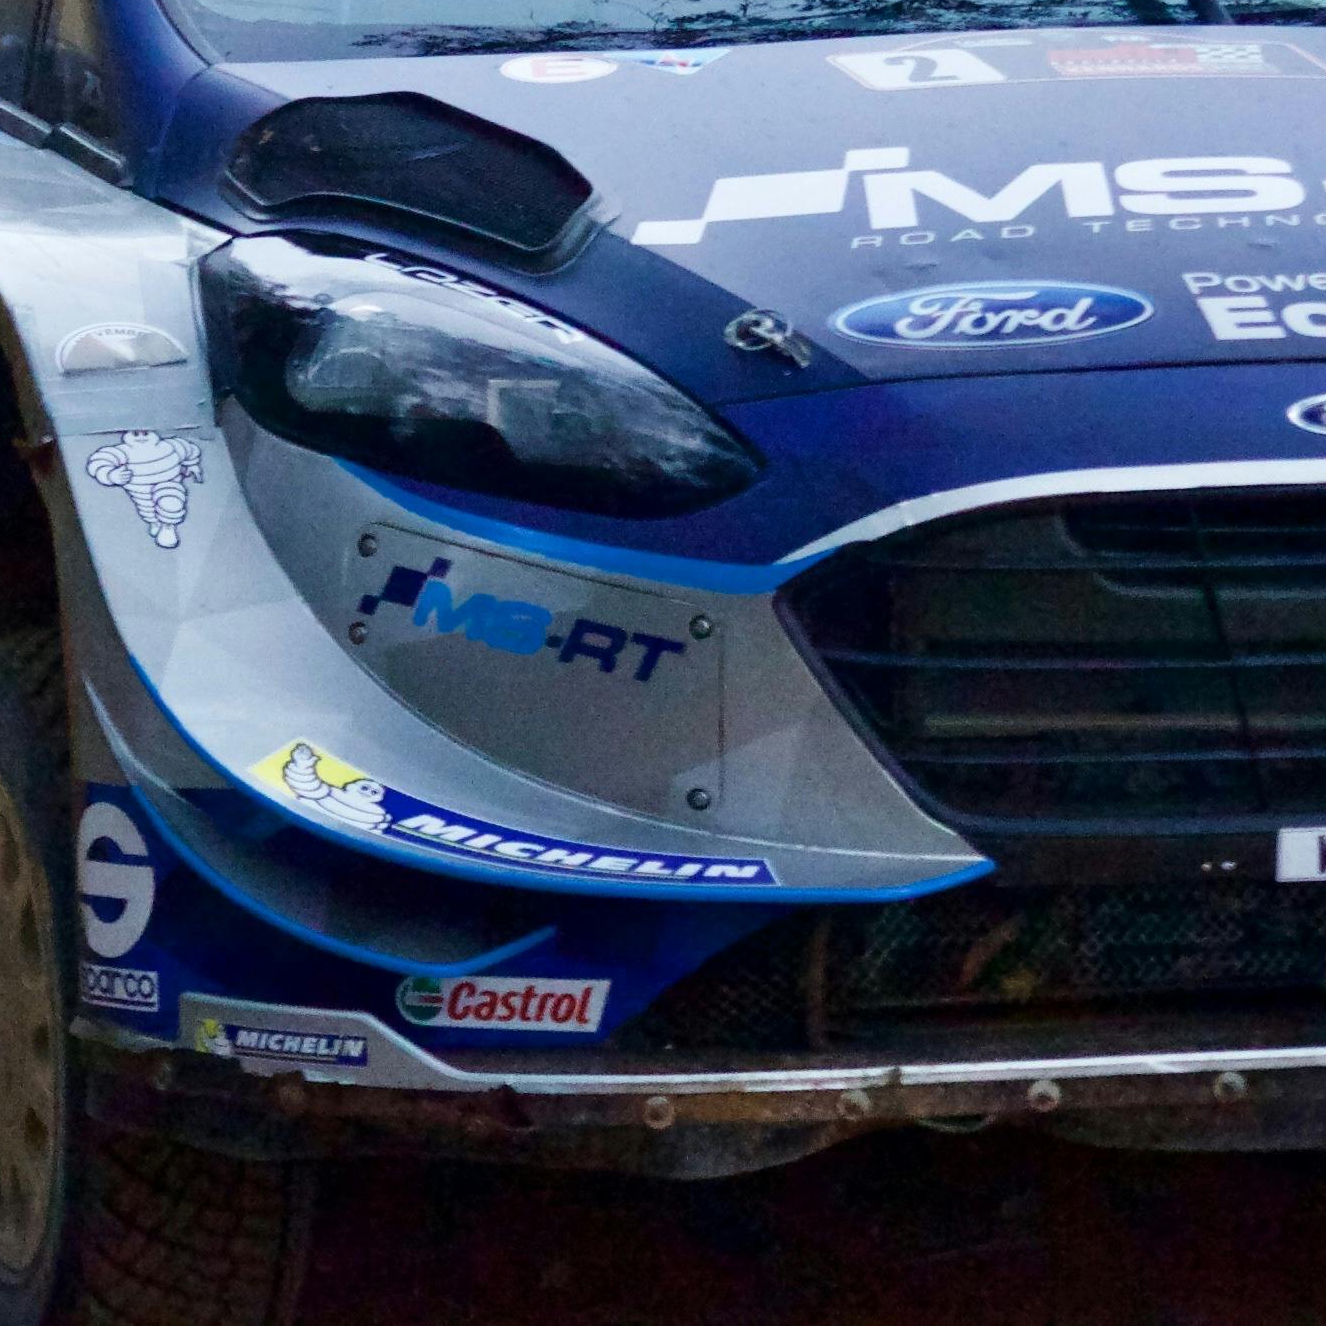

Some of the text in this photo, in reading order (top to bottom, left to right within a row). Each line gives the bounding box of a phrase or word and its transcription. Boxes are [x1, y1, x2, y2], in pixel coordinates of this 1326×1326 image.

[883, 55, 962, 83] 2
[850, 224, 1036, 251] ROAD
[895, 286, 1099, 339] Ford
[403, 814, 760, 878] MICHELIN
[85, 967, 154, 998] parco
[446, 980, 592, 1026] Castrol
[234, 1029, 366, 1057] MICHELIN
